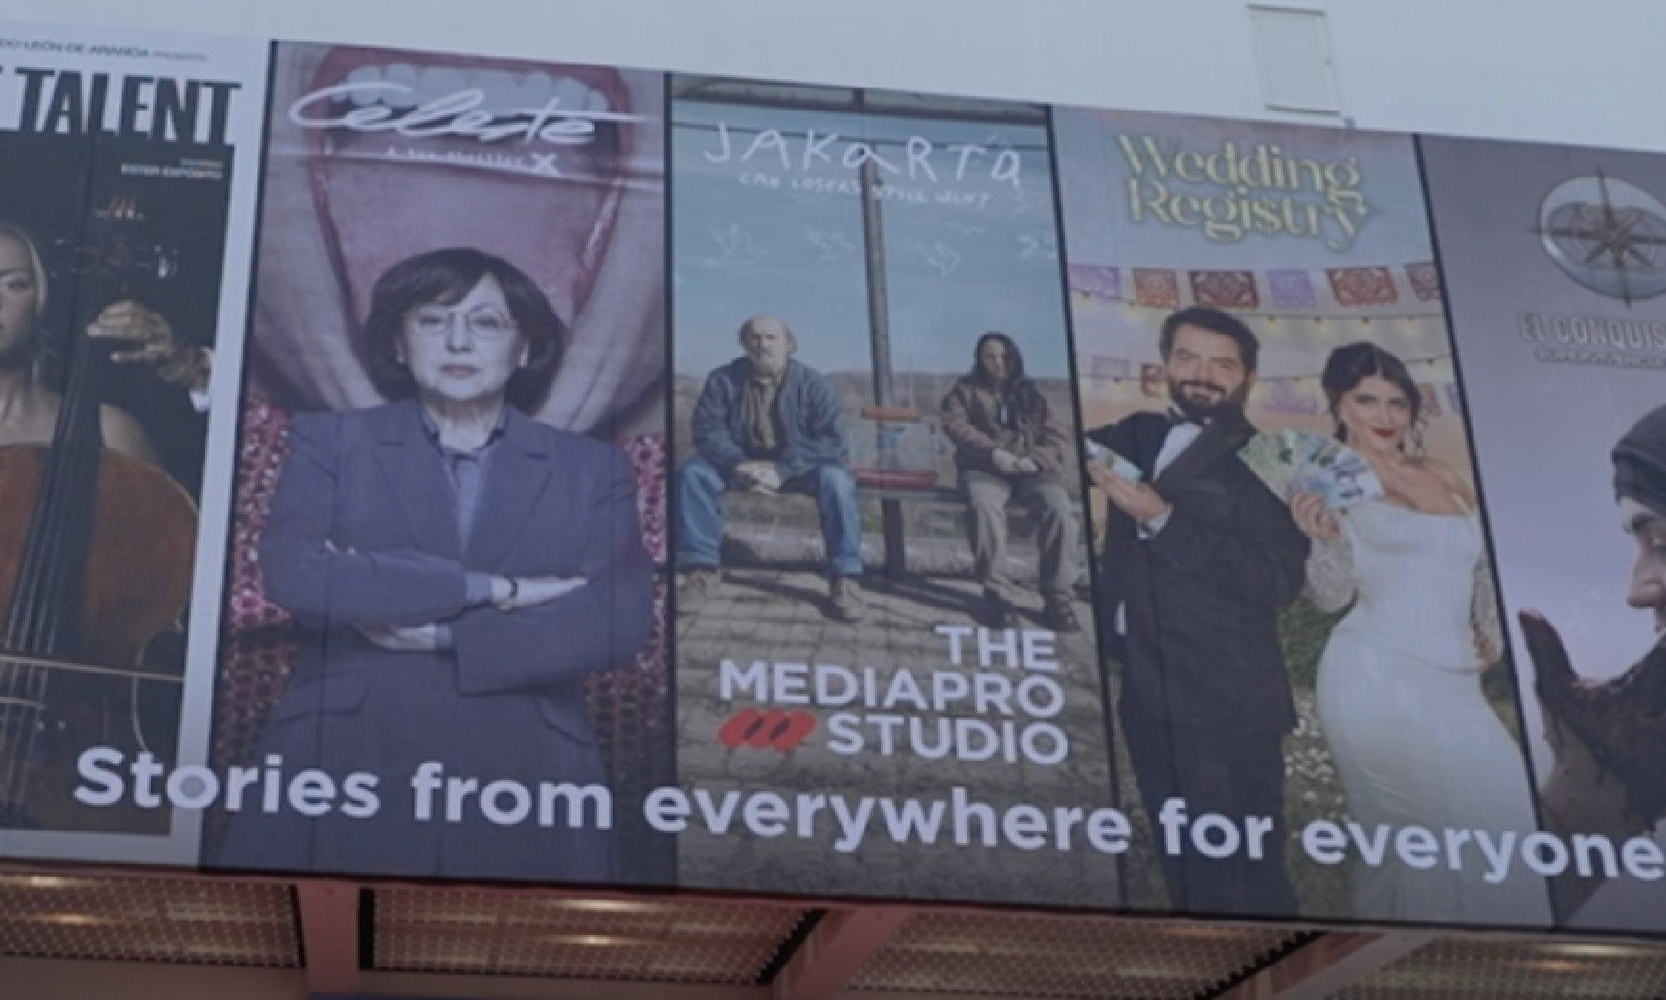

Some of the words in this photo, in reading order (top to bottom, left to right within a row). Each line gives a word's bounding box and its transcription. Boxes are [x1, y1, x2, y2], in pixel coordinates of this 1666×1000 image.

[15, 66, 241, 143] TALENT
[290, 82, 643, 145] Celeste
[1116, 132, 1367, 217] Wedding
[1126, 176, 1359, 254] Registry
[934, 624, 1062, 672] THE
[718, 657, 1066, 719] MEDIAPRO
[826, 711, 1070, 766] STUDIO
[74, 746, 380, 817] Stories
[412, 761, 612, 829] from
[644, 784, 1133, 854] everywhere
[1157, 797, 1273, 860] for
[1303, 815, 1666, 884] everyone
